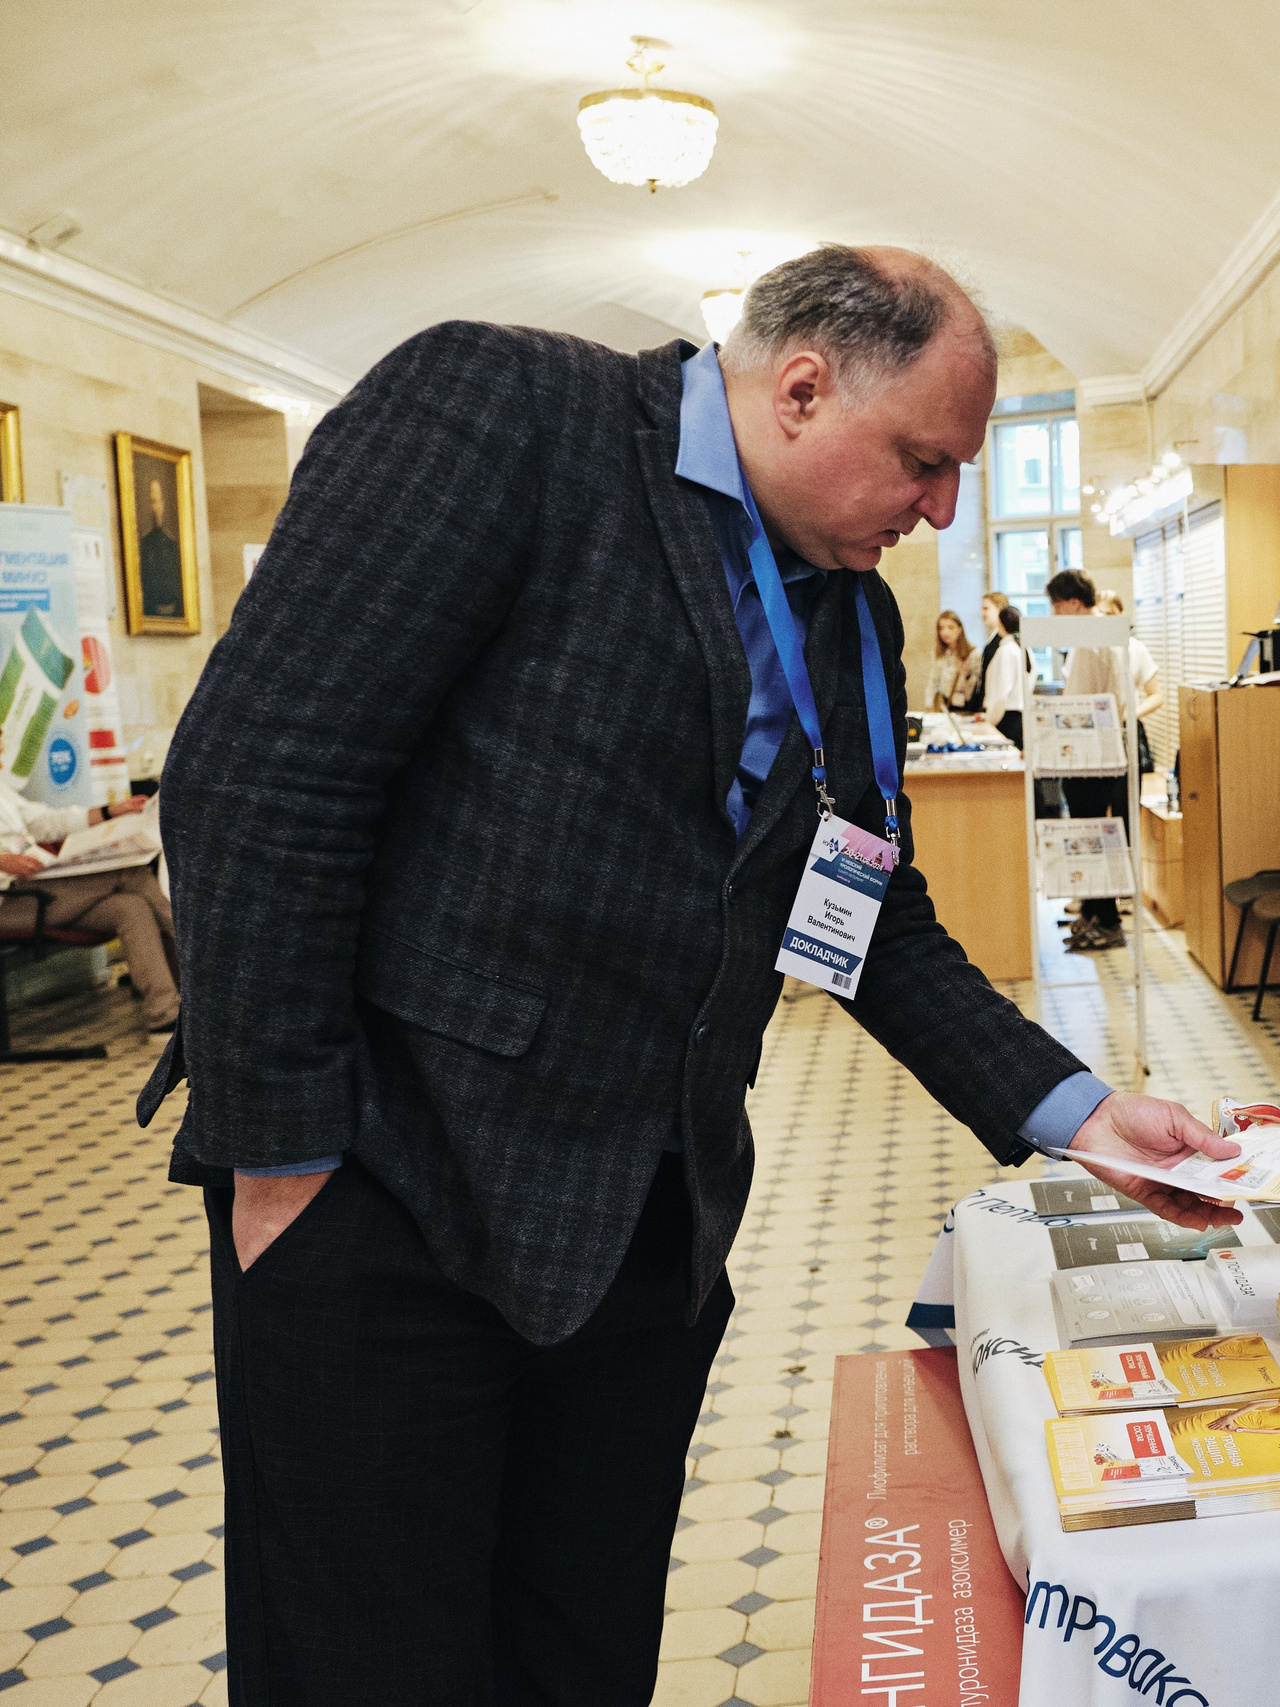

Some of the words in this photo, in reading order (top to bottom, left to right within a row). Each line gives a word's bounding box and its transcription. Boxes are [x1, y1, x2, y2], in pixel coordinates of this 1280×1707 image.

[823, 898, 853, 917] Кузьмин
[824, 911, 845, 926] Игорь
[807, 915, 856, 943] Валентинович
[789, 936, 850, 969] ДОКЛАДЧИК
[1190, 1363, 1209, 1388] ЗАЩИТА
[1206, 1361, 1227, 1388] ТРОЙНАЯ
[873, 1422, 889, 1438] для
[903, 1414, 922, 1456] раствора
[1133, 1425, 1145, 1442] СОСТАВ
[1190, 1437, 1206, 1461] МОЧЕВЫХ
[1201, 1459, 1212, 1477] ПУТЕЙ
[1203, 1436, 1225, 1466] ЗАЩИТА
[1221, 1434, 1243, 1468] ТРОЙНАЯ
[867, 1439, 891, 1500] Лиофилизат
[948, 1519, 973, 1598] азоксимер
